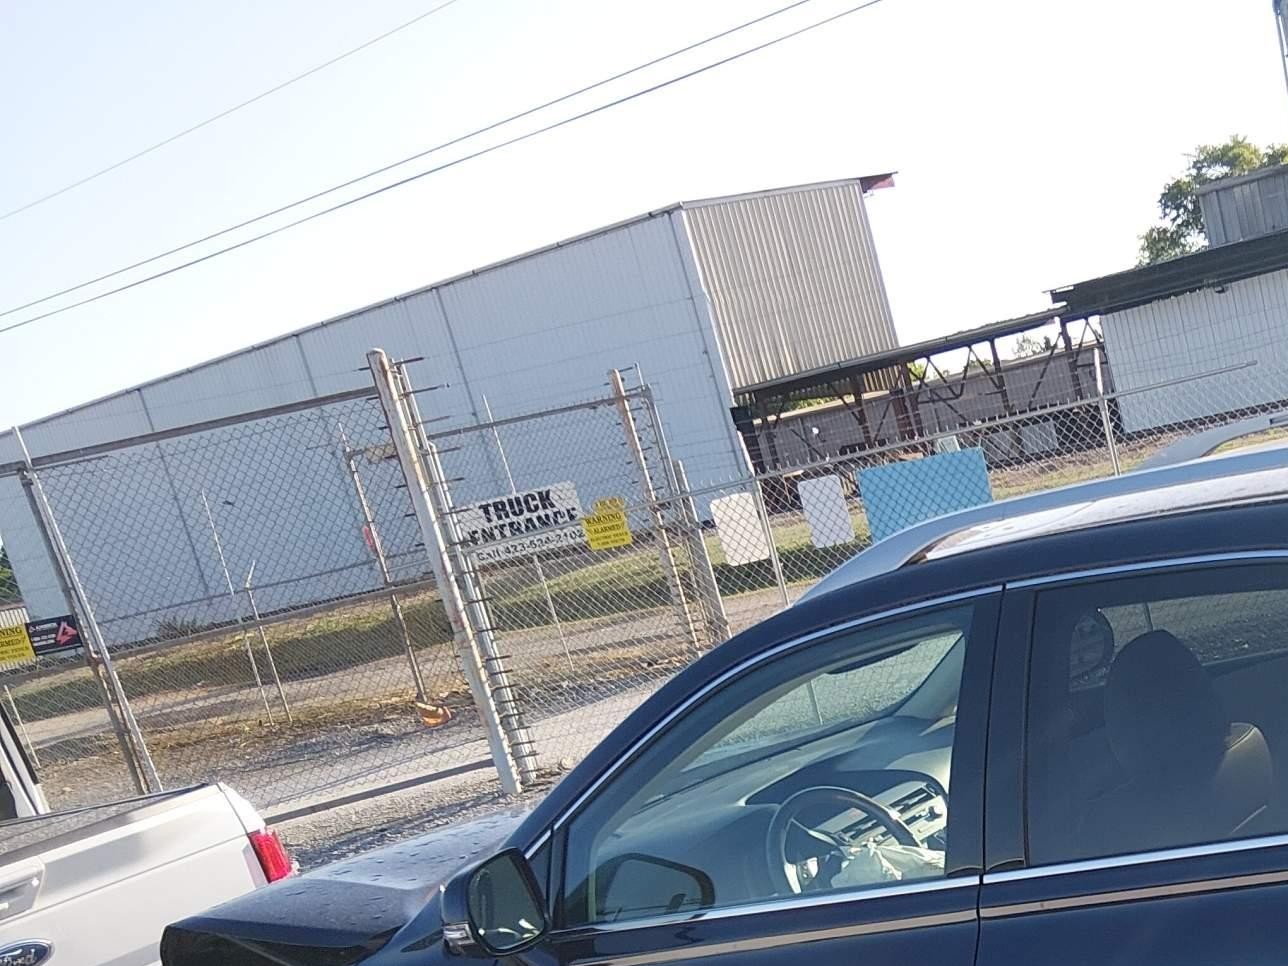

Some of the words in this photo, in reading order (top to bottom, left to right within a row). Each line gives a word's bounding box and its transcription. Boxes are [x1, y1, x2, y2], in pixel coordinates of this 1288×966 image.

[478, 489, 556, 523] TRUCK
[584, 512, 622, 526] WARNING
[466, 507, 577, 546] ENTRANCE
